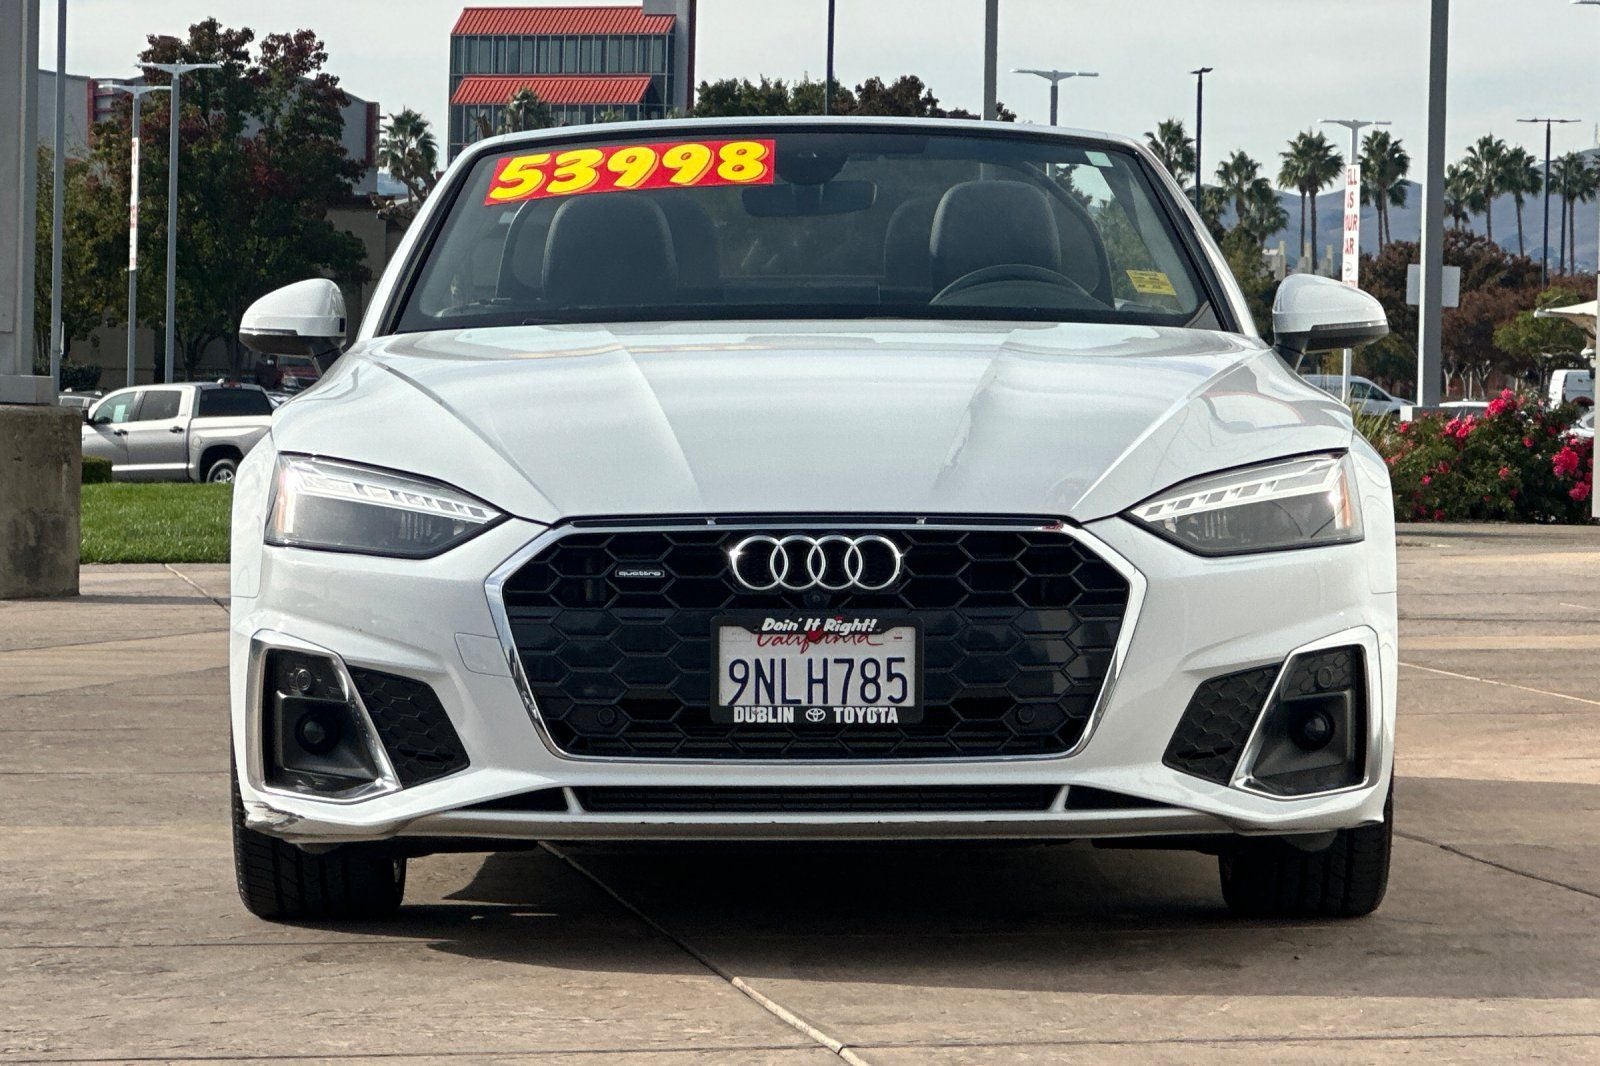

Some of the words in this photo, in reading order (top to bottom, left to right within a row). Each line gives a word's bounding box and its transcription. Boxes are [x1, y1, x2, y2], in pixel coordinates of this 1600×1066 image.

[489, 141, 770, 200] 53998
[761, 617, 802, 632] Doin'
[804, 618, 820, 632] It
[823, 618, 878, 636] Right!
[728, 657, 908, 705] 9NLH785
[733, 706, 795, 724] DUBLIN
[833, 706, 899, 724] TOYOTA
